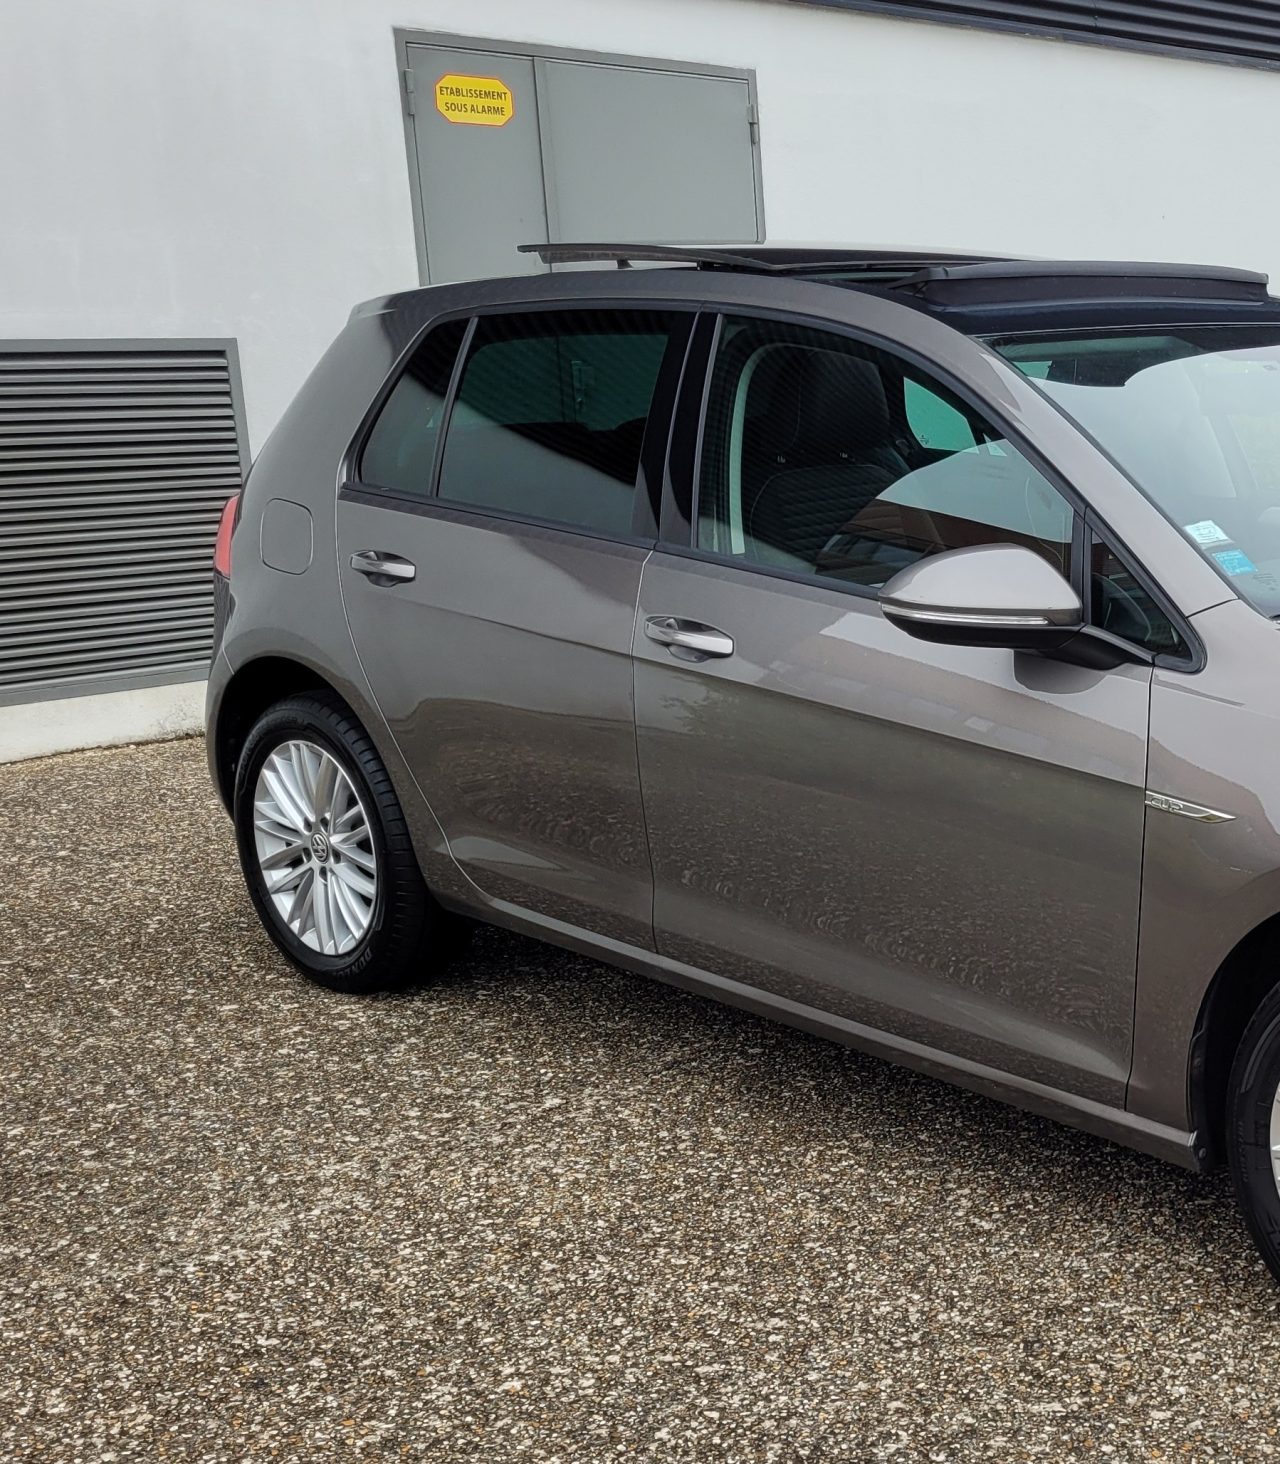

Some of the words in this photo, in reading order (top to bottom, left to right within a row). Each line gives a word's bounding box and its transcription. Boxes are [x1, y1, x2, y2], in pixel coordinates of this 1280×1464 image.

[439, 86, 508, 101] ETABLISSEMENT
[444, 102, 468, 113] SOUS
[470, 104, 506, 116] ALARME
